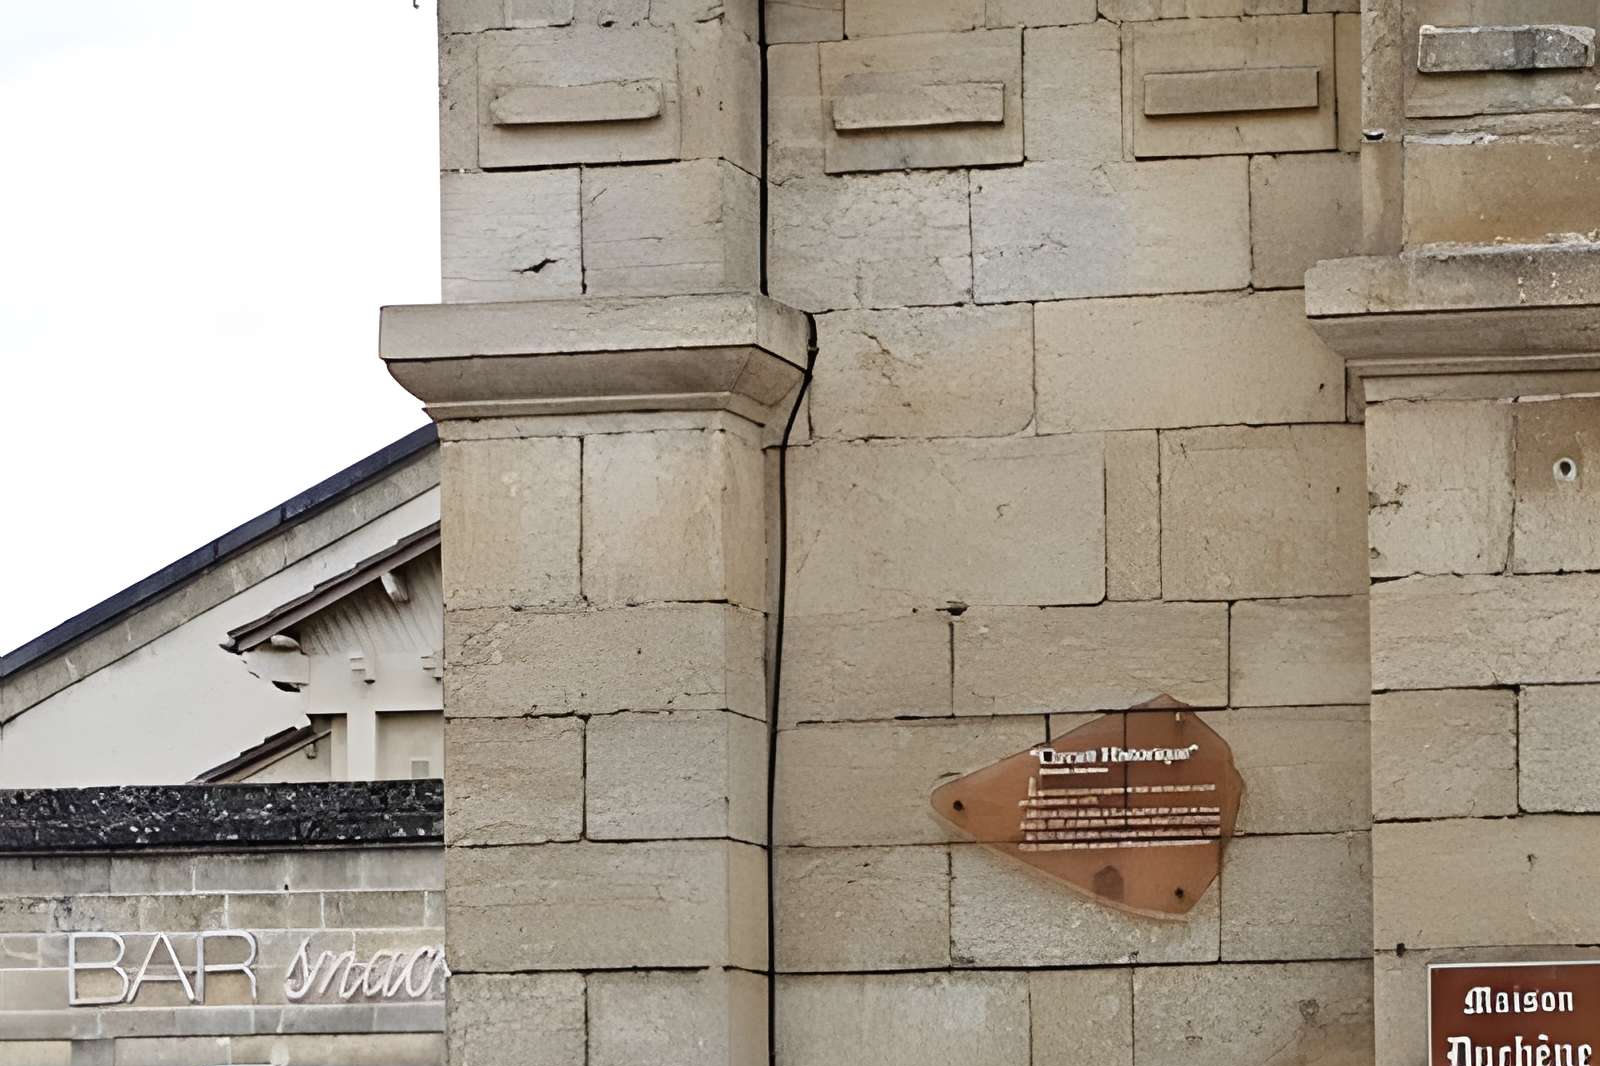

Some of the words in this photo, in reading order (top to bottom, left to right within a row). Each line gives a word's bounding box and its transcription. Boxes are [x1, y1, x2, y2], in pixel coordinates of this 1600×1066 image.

[69, 931, 258, 1006] BAR
[284, 935, 446, 1000] snac
[1464, 986, 1574, 1014] Maison
